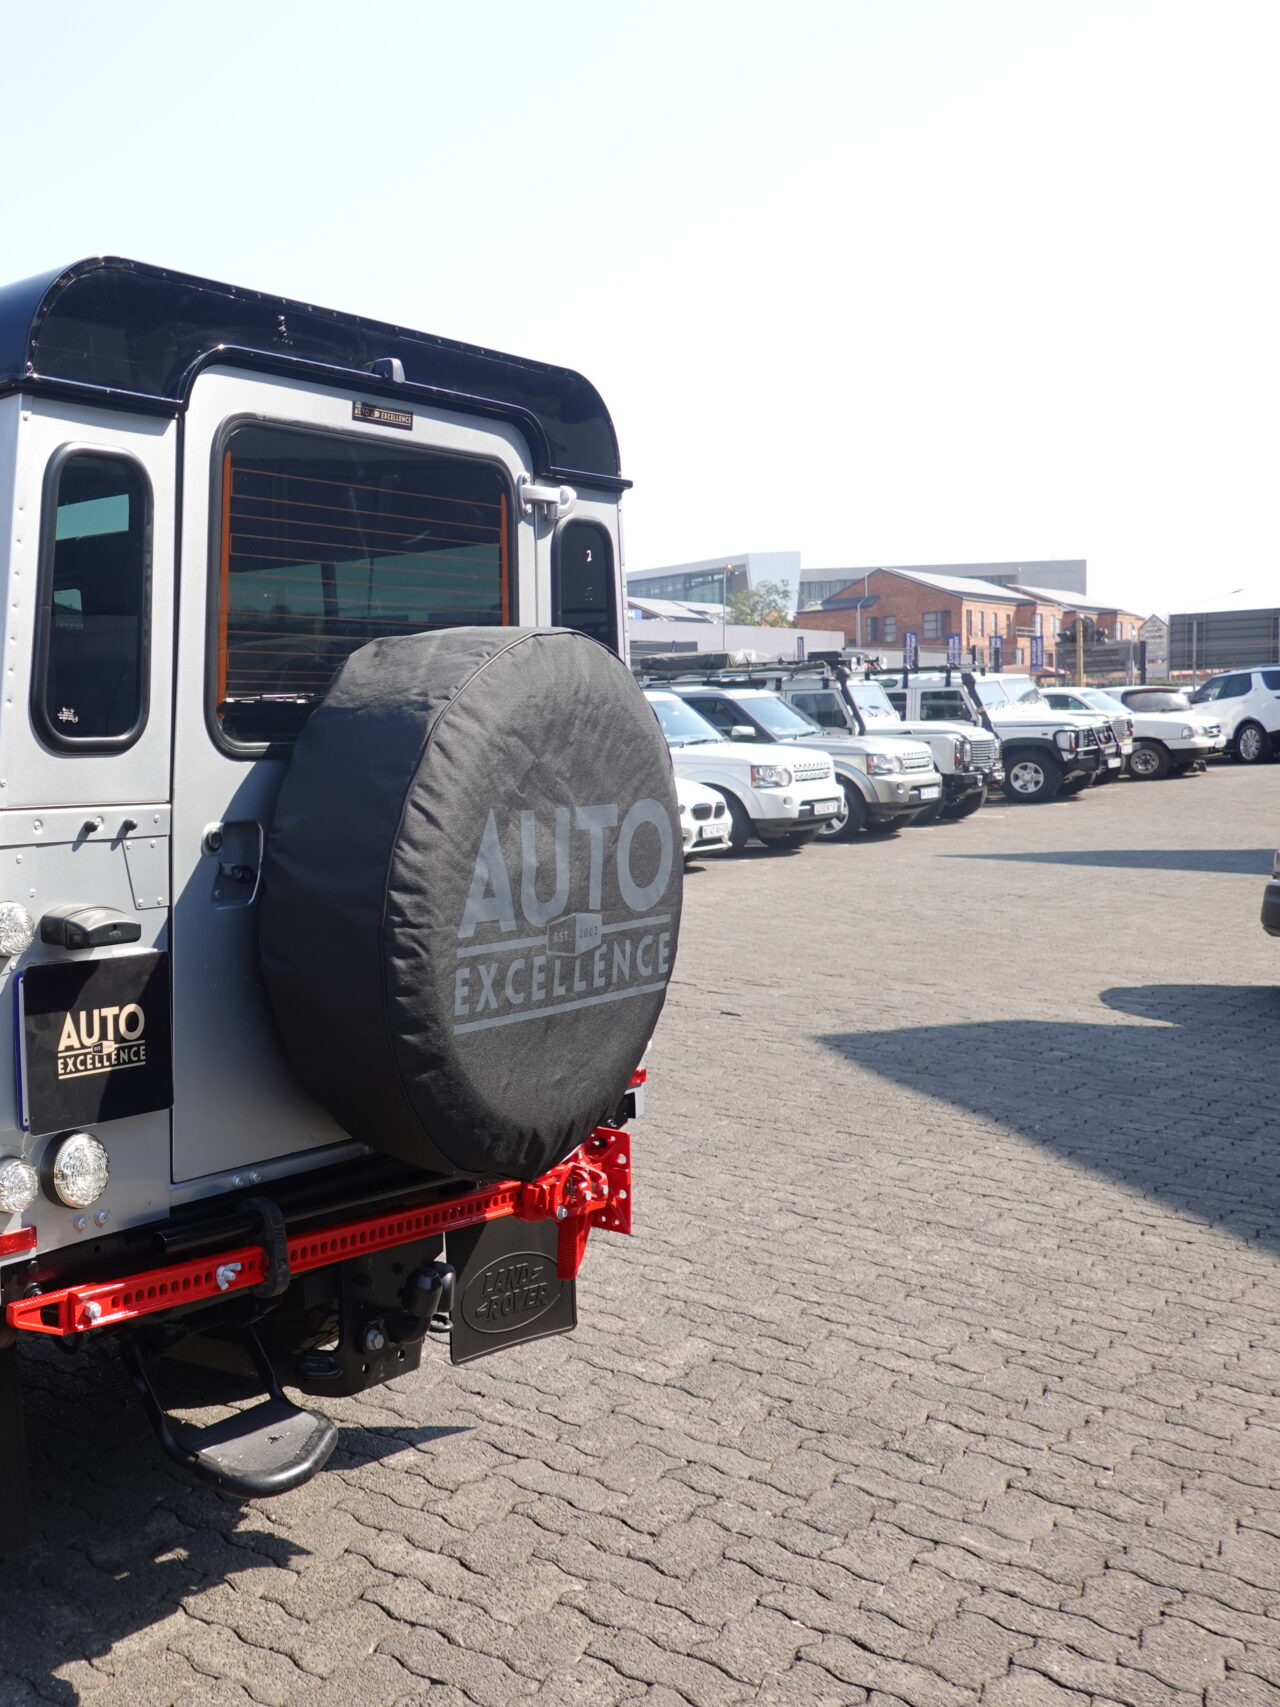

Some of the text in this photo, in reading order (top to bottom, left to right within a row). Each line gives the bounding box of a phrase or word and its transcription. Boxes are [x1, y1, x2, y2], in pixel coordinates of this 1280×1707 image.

[380, 411, 412, 424] EXCELLENCE
[458, 798, 674, 939] AUTO
[454, 932, 671, 1016] EXCELLENCE
[57, 1003, 145, 1052] AUTO
[58, 1045, 146, 1075] EXCELLENCE
[481, 1262, 529, 1298] LAND
[486, 1282, 549, 1320] ROVER
